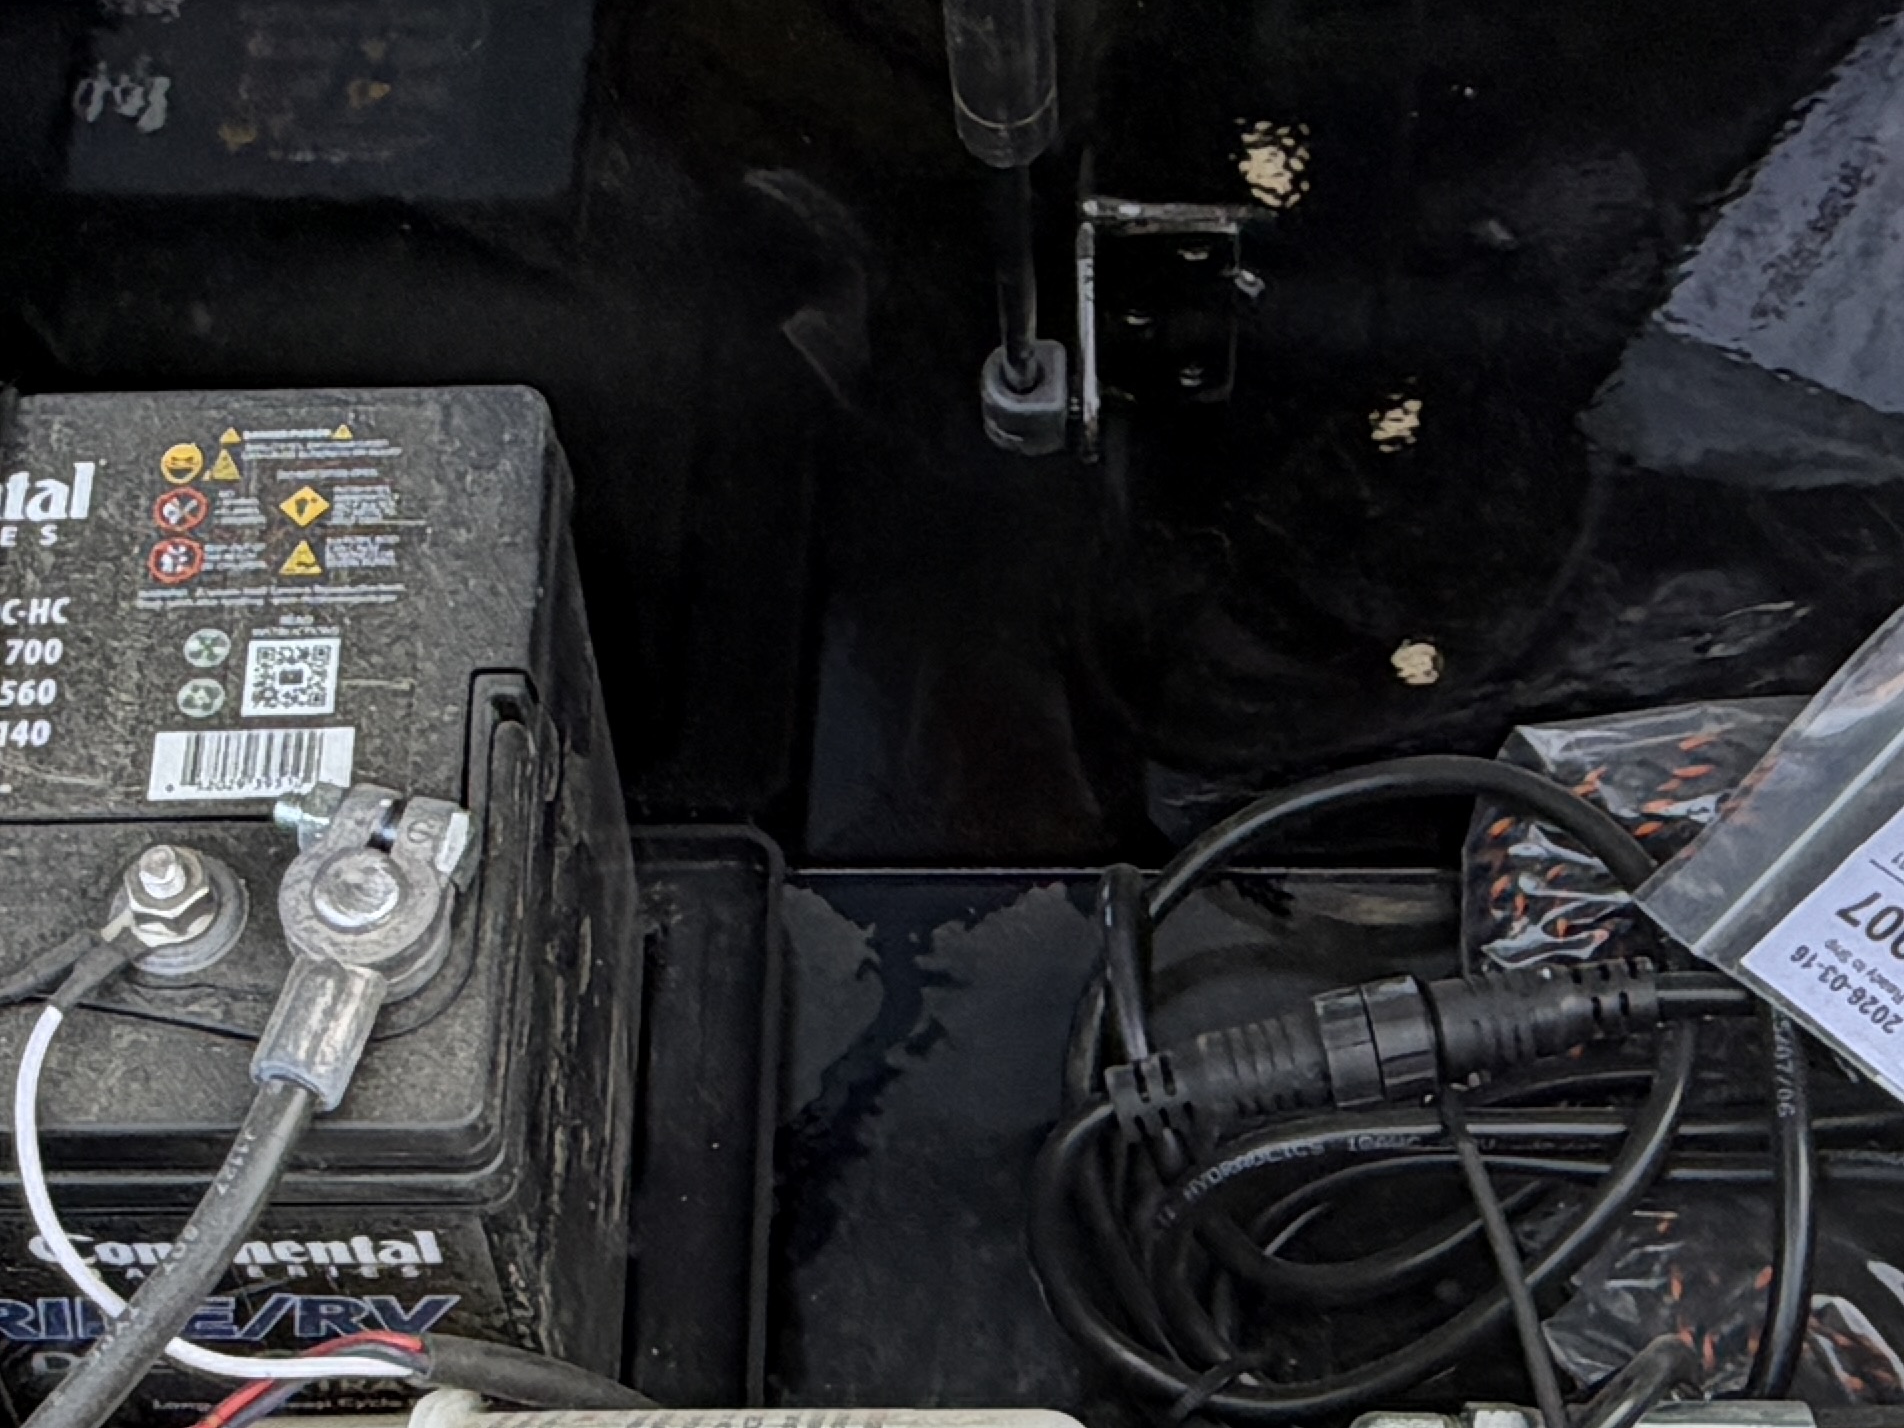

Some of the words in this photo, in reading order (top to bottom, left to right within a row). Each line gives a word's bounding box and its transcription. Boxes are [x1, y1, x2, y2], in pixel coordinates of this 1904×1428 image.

[5, 639, 63, 665] 700
[1789, 944, 1904, 1034] 2026-03-16
[28, 1230, 443, 1267] Connental
